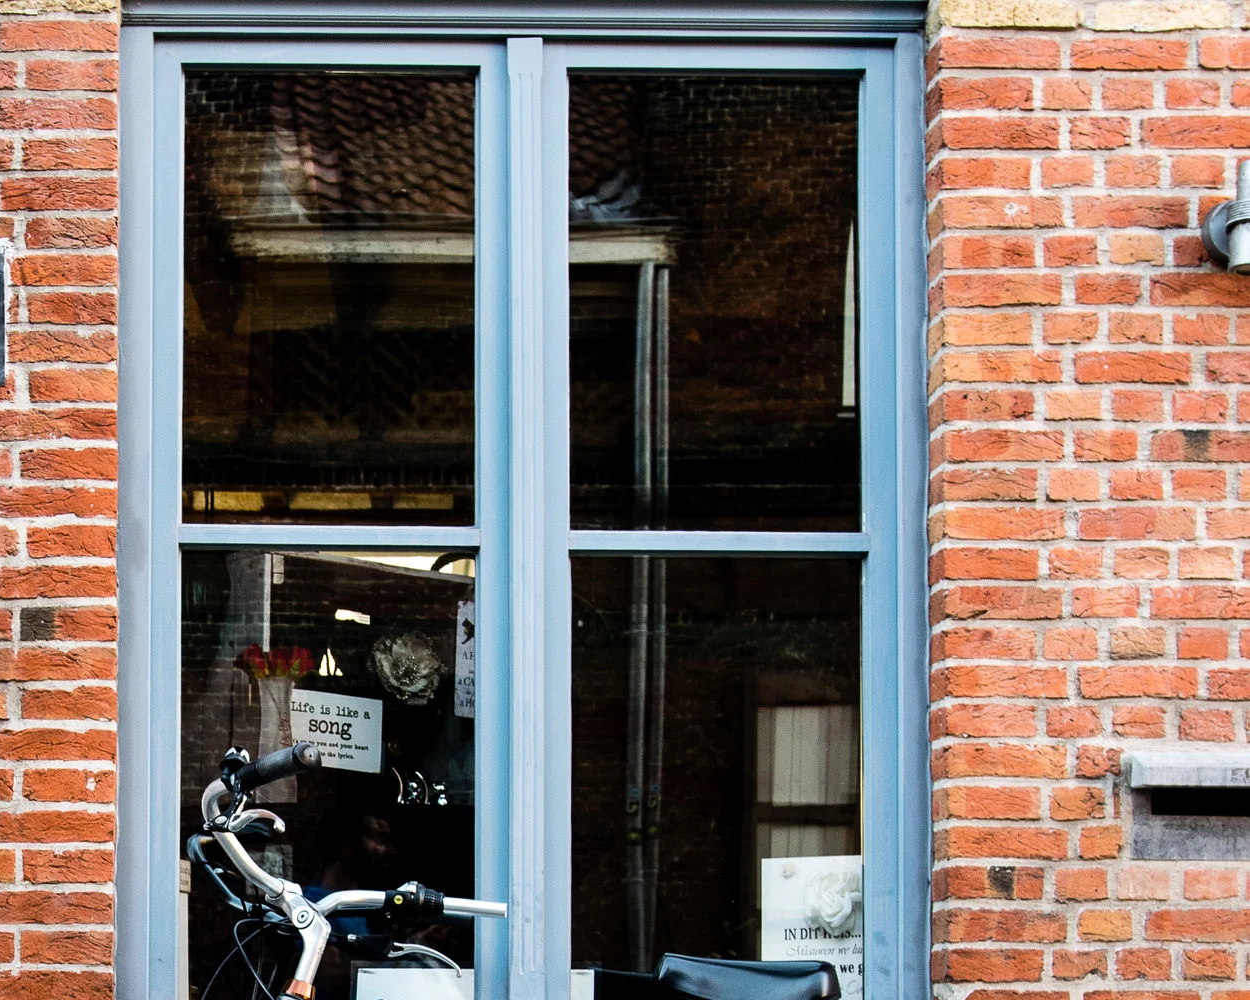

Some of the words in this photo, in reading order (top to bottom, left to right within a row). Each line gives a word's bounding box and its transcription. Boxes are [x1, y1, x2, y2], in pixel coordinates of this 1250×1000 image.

[291, 701, 315, 713] Life
[320, 704, 330, 715] is
[336, 706, 359, 718] like
[363, 711, 370, 719] a
[309, 719, 352, 740] song
[354, 743, 369, 751] heart
[784, 928, 797, 940] IN
[800, 927, 820, 939] DIT
[840, 964, 854, 974] we
